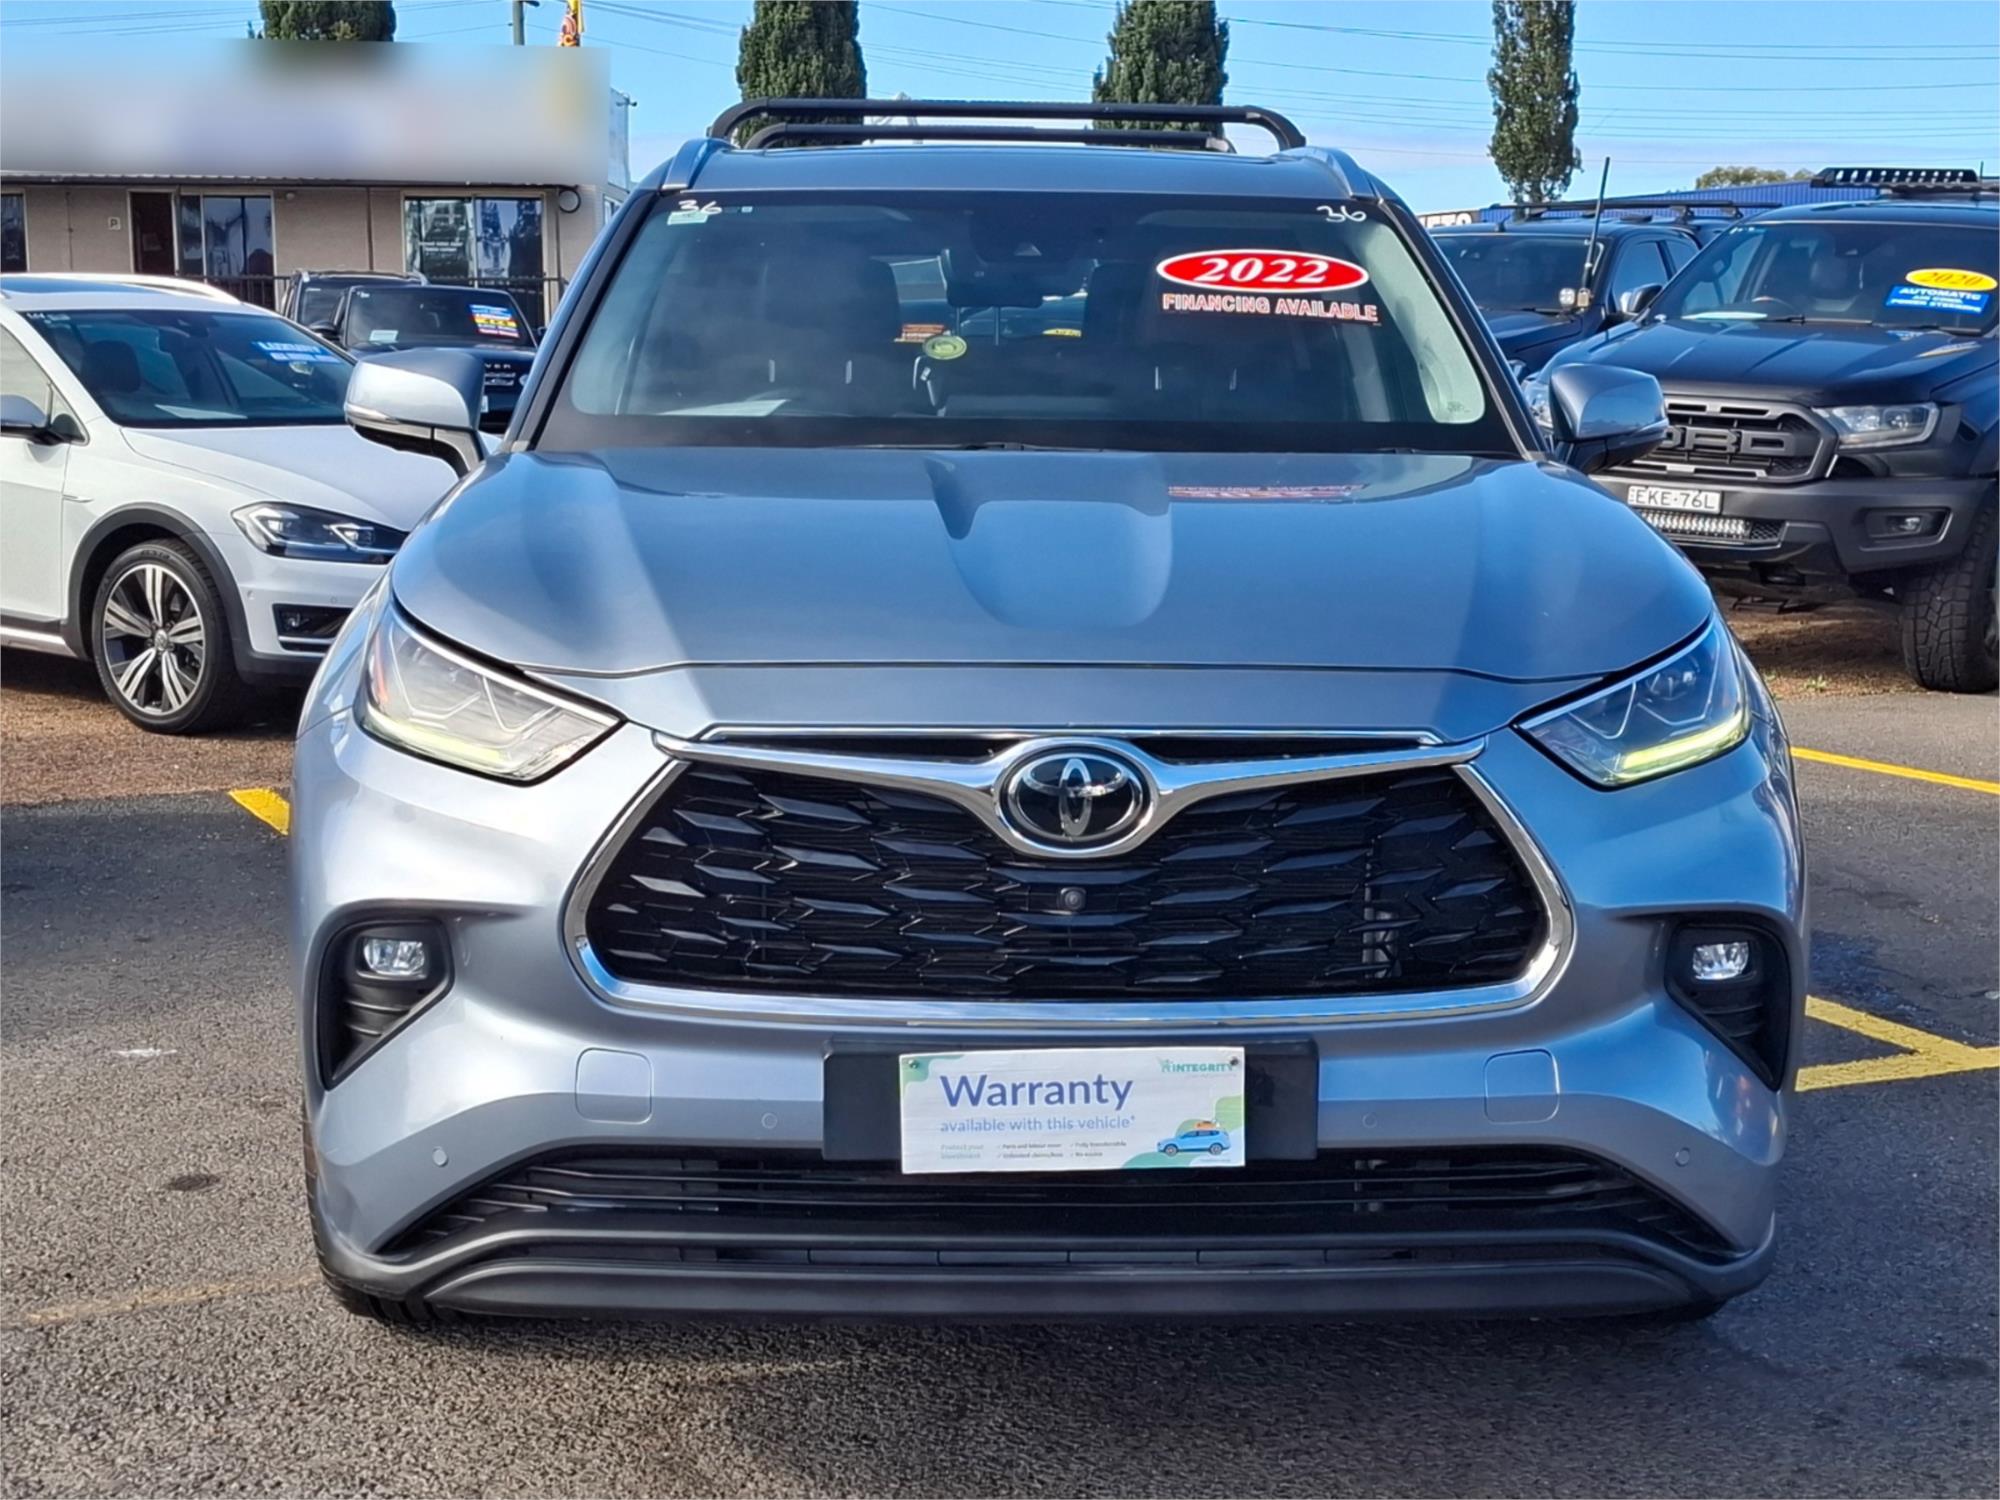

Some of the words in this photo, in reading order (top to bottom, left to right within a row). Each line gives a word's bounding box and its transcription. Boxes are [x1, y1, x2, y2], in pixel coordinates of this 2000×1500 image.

[1316, 205, 1367, 222] 36
[1193, 257, 1329, 283] 2022
[1920, 272, 1985, 286] 2020
[1899, 287, 1982, 300] AUTOMATIC
[1162, 293, 1270, 314] FINANCING
[1275, 298, 1378, 322] AVAILABLE
[939, 1073, 1134, 1111] Warranty
[939, 1117, 1006, 1133] available
[1009, 1115, 1043, 1131] with
[1047, 1115, 1075, 1130] this
